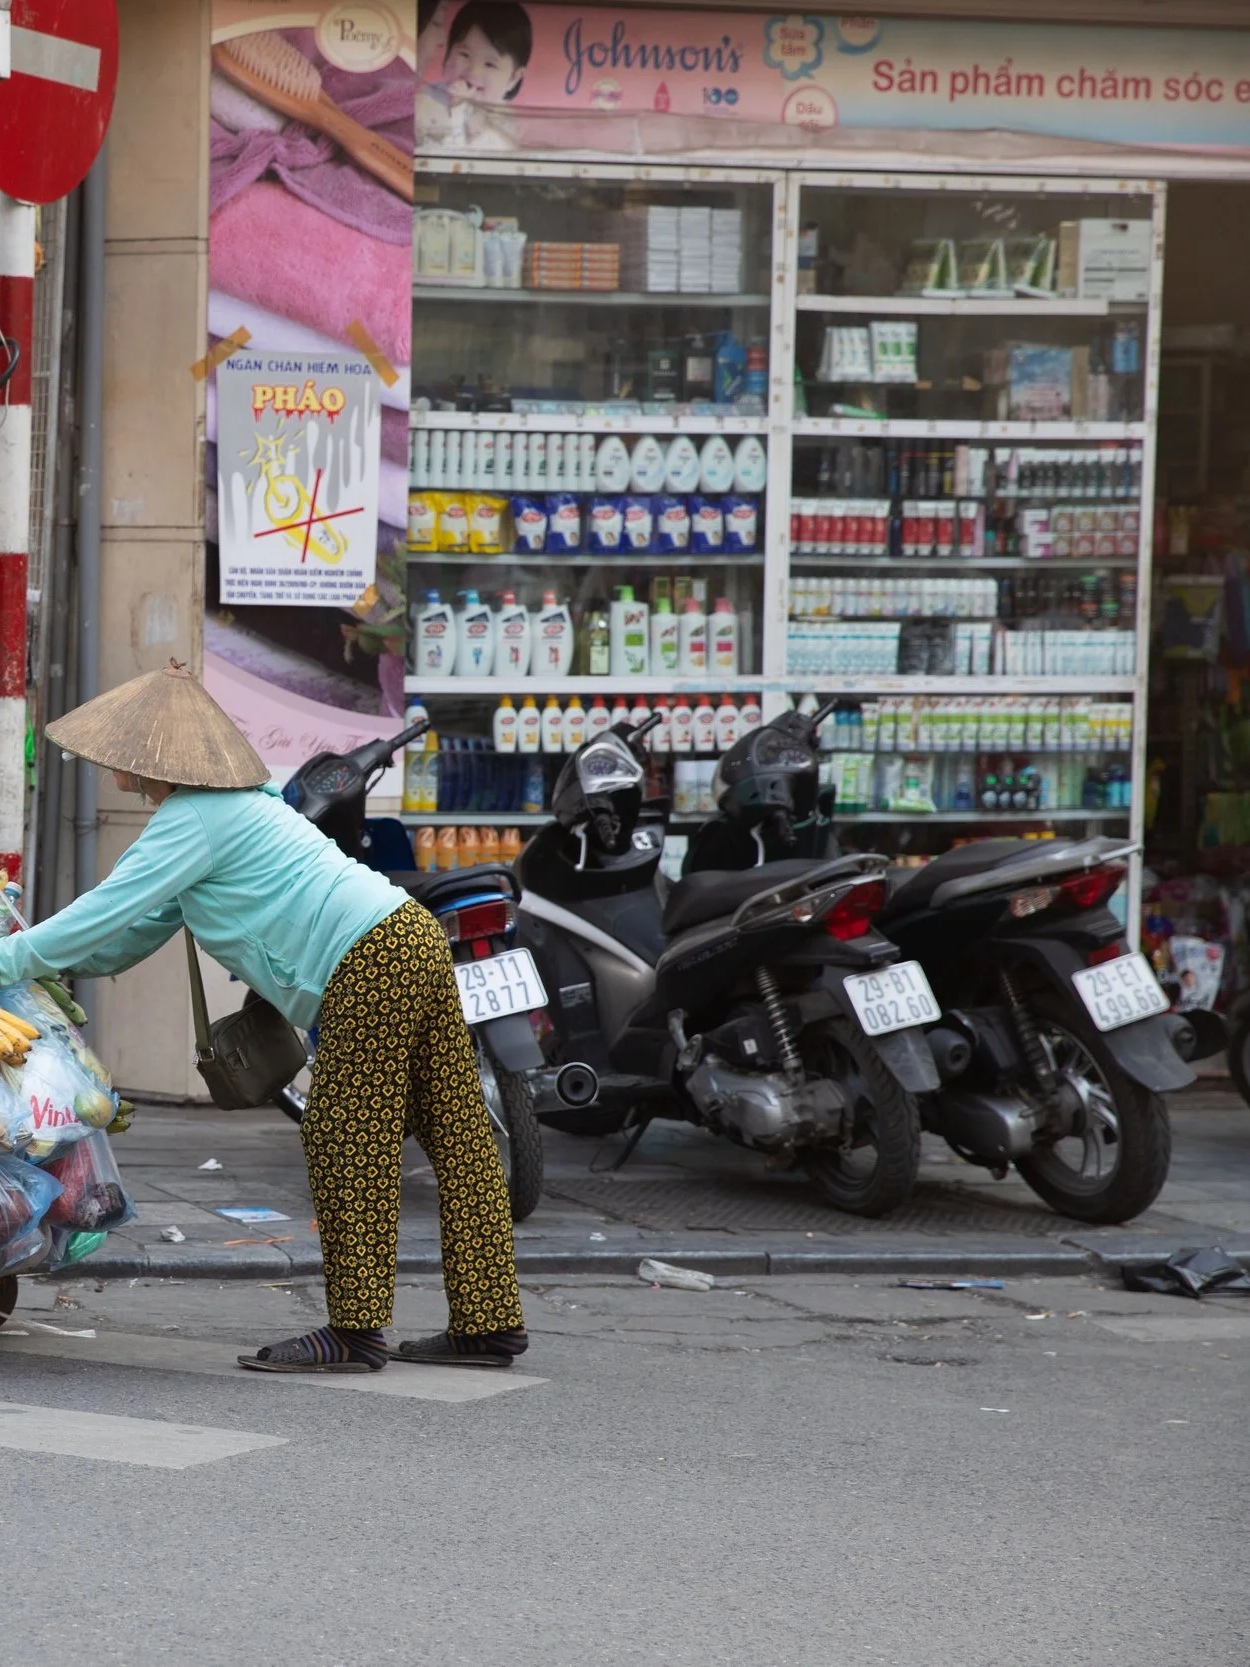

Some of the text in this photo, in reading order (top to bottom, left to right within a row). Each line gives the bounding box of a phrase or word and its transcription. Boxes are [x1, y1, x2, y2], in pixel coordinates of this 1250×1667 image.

[563, 17, 740, 95] Johnson's
[872, 57, 939, 94] Sản
[949, 57, 1045, 103] phẩm
[1055, 67, 1152, 100] chăm
[1163, 72, 1224, 102] sóc
[252, 378, 346, 415] PHÁO
[459, 955, 522, 991] 29-T1
[857, 970, 916, 1002] 29-B1
[1085, 961, 1142, 998] 29-E1
[469, 981, 530, 1017] 2877
[863, 994, 933, 1030] 082.60
[1095, 985, 1161, 1024] 499.66
